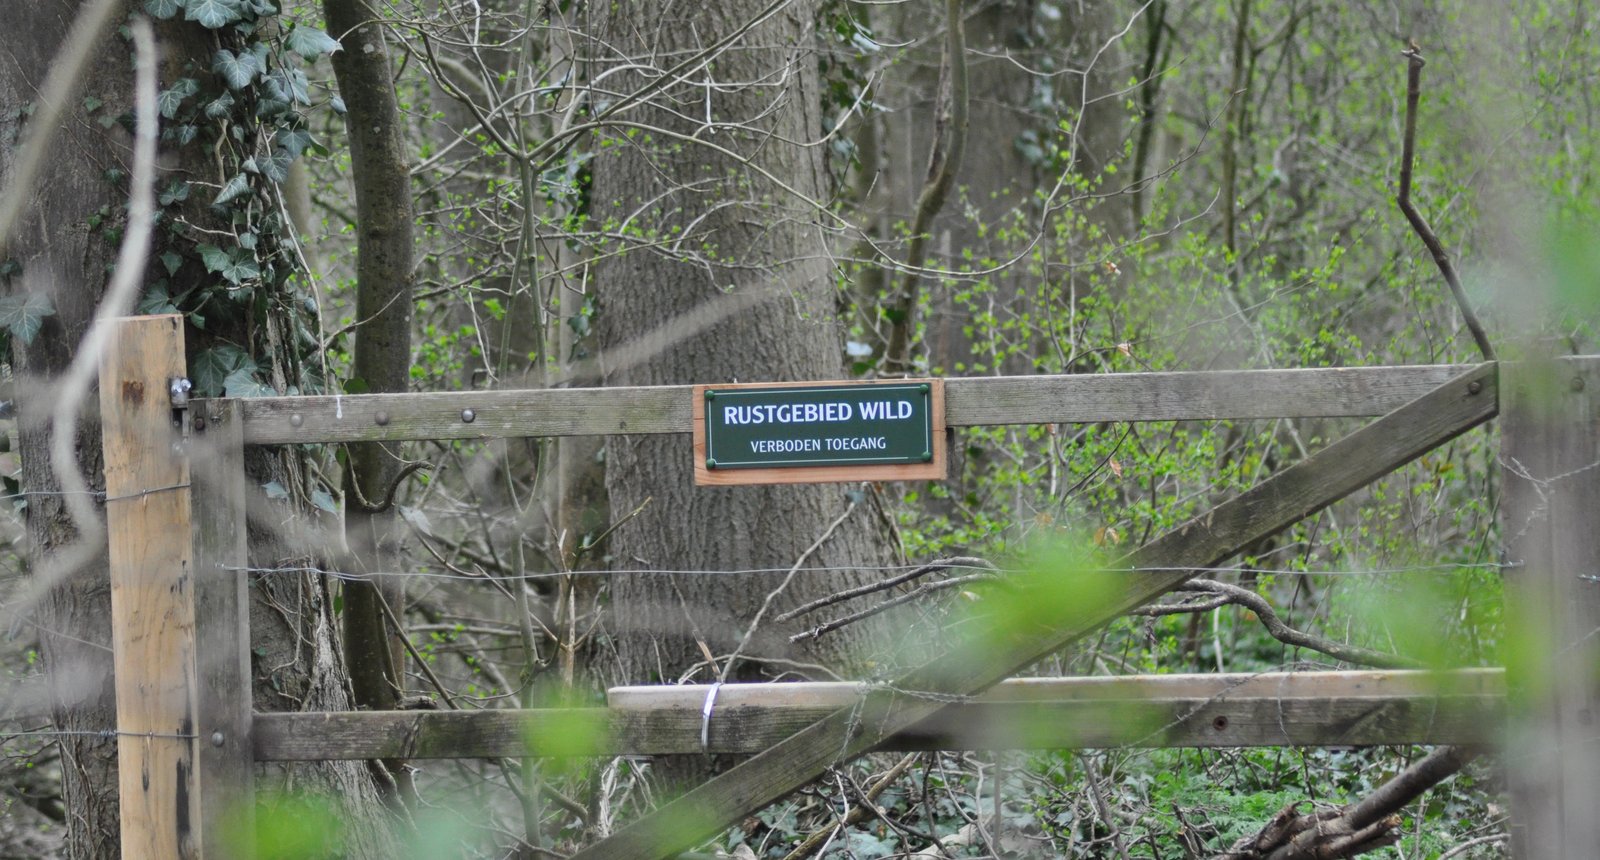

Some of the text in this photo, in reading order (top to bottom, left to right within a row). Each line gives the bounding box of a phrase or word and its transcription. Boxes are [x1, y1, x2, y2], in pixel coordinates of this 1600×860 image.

[724, 400, 913, 425] RUSTGEBIED WILD
[750, 436, 887, 453] VERBODEN TOEGANG
